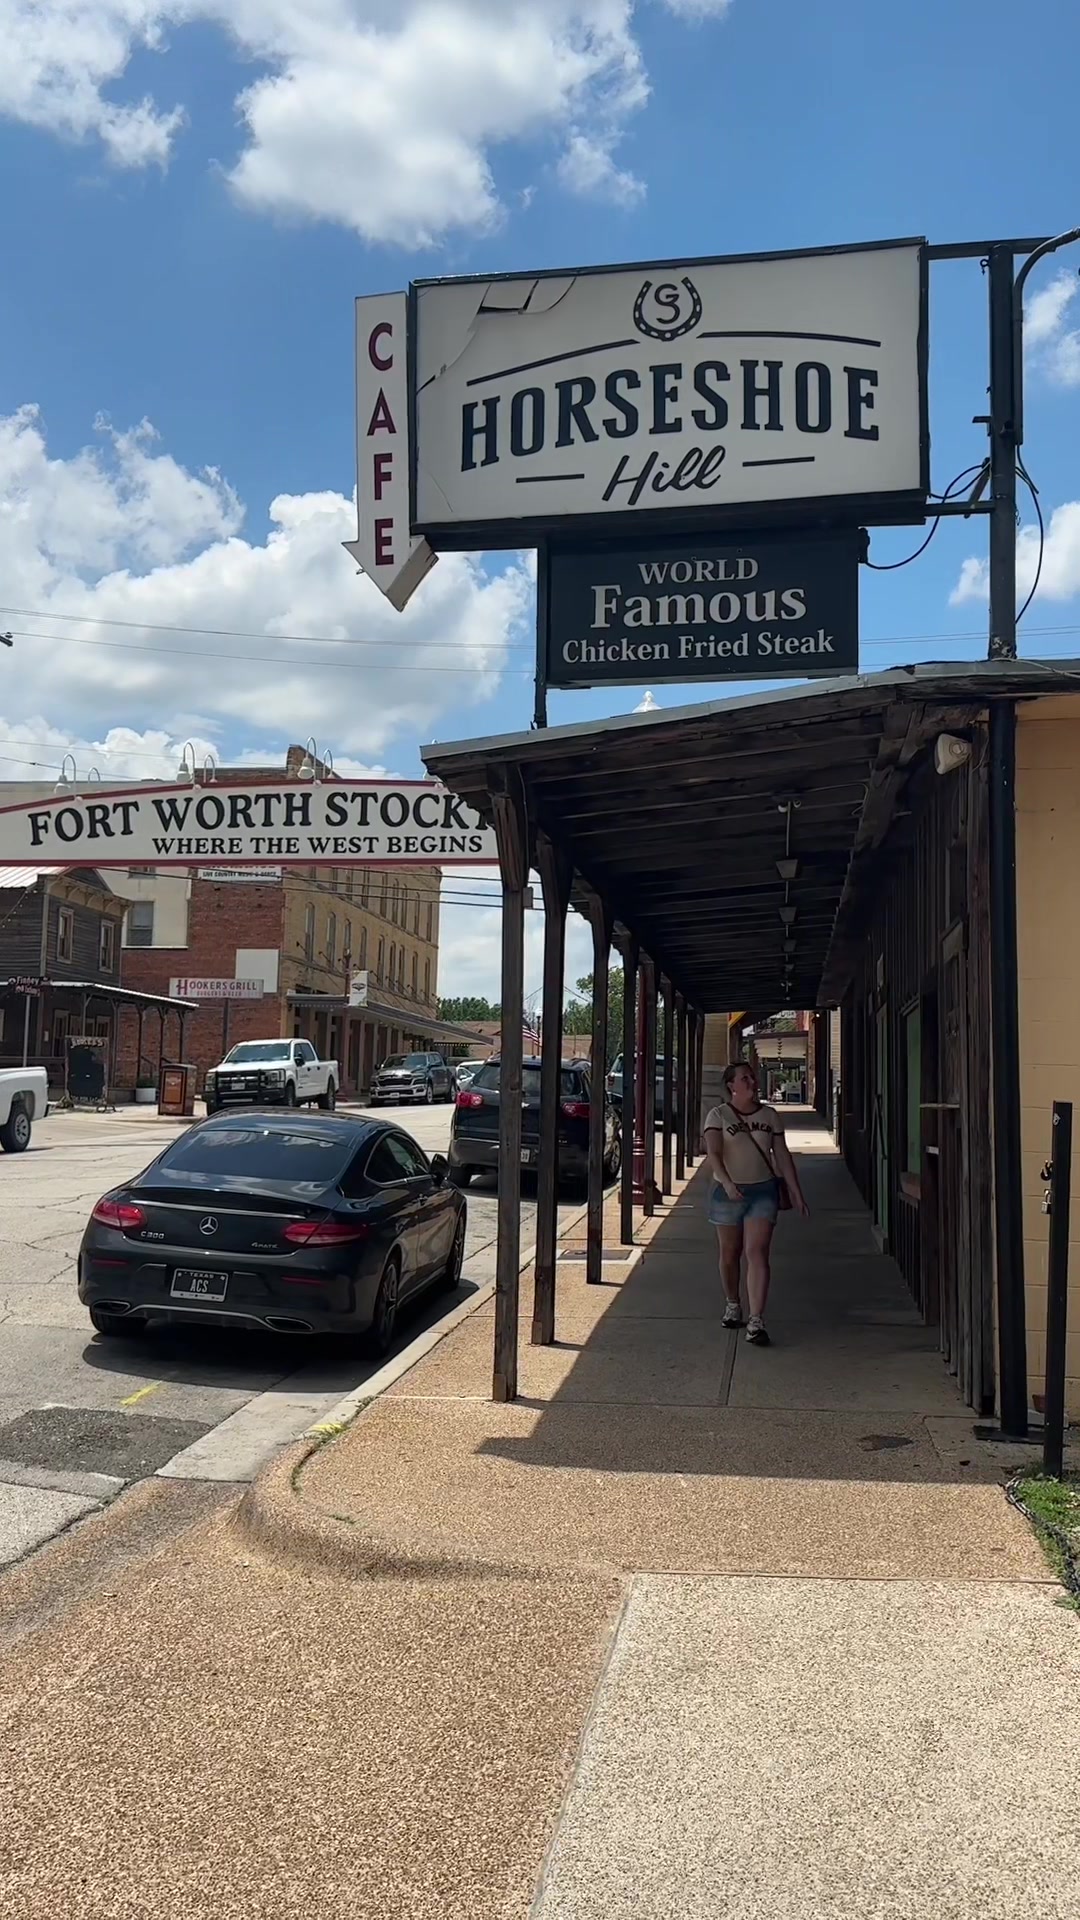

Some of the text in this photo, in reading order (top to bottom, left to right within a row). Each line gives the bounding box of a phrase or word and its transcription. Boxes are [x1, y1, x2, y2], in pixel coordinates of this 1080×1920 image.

[461, 359, 880, 473] HORSESHOE
[366, 322, 397, 567] CAFE
[601, 445, 727, 506] Hill
[637, 557, 759, 586] WORLD
[590, 583, 808, 629] Famous
[562, 629, 835, 666] Chicken Fried Steak
[28, 801, 140, 847] FORT
[151, 792, 314, 833] WORTH
[152, 834, 483, 855] WHERE THE WEST BEGINS
[176, 979, 257, 995] HOOKERS GRILL
[190, 1278, 209, 1293] ACS
